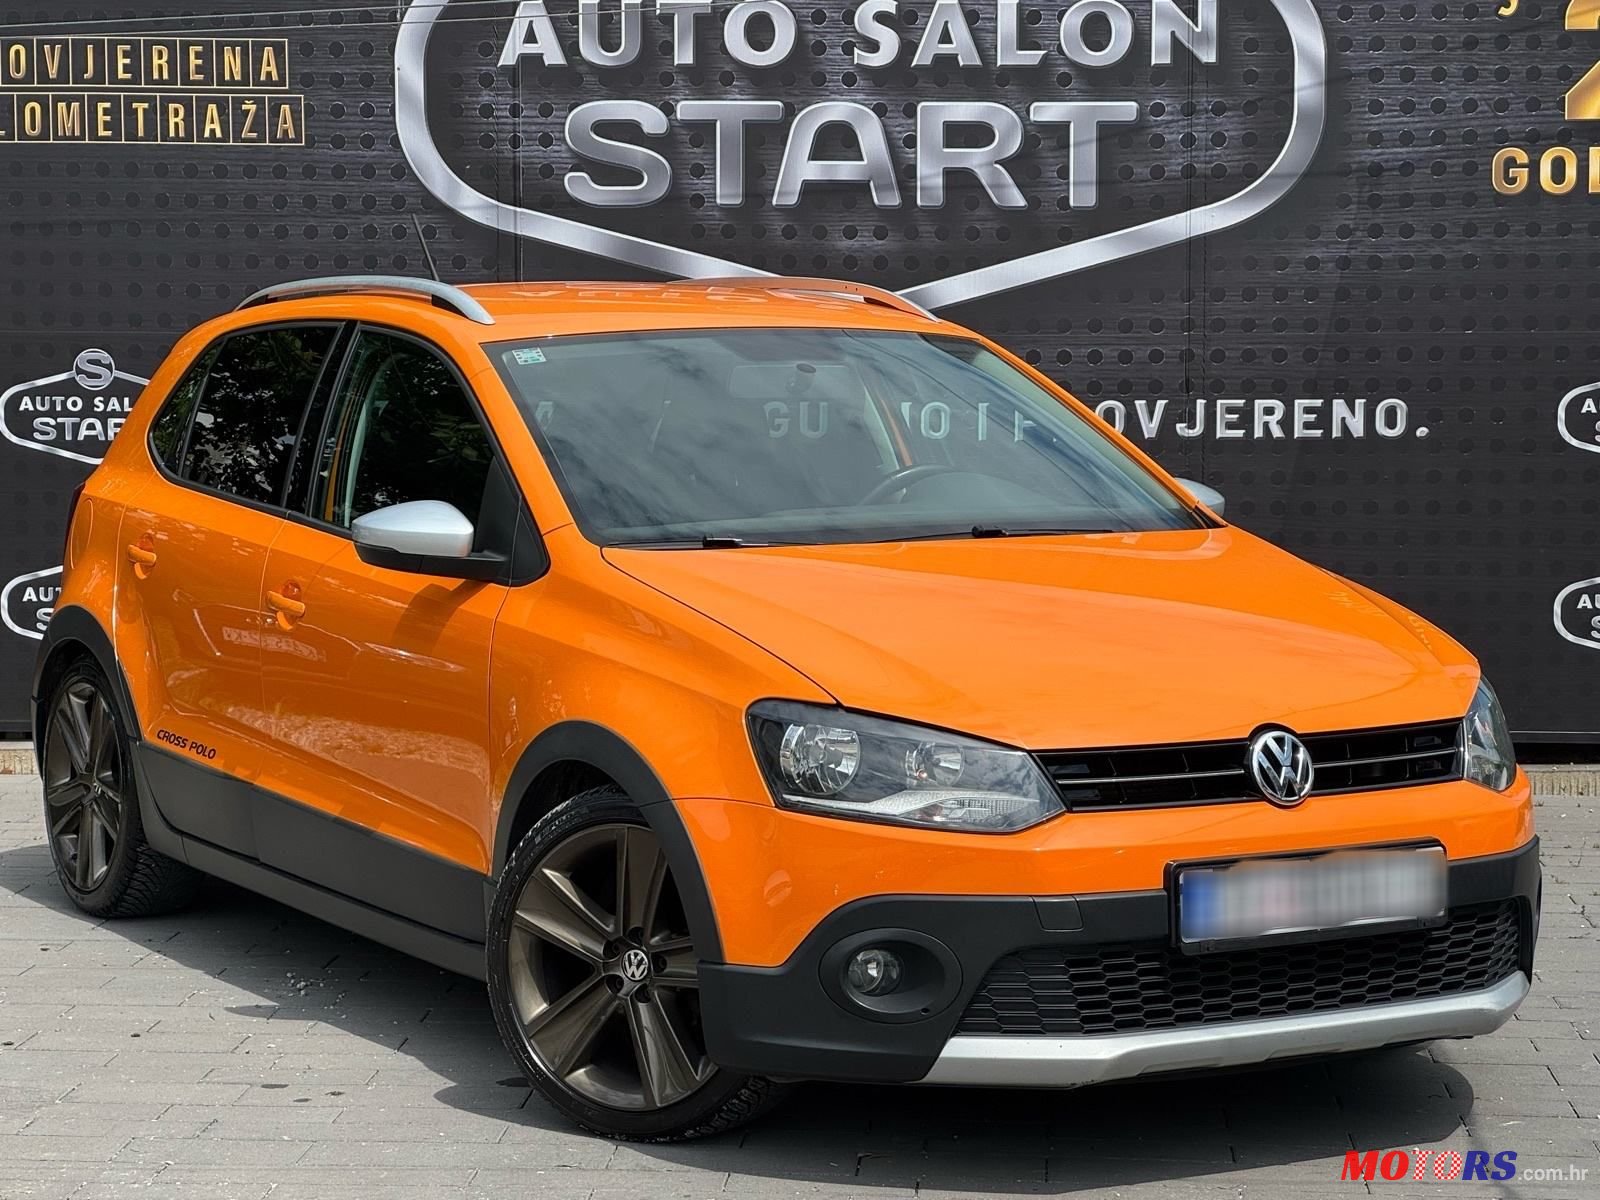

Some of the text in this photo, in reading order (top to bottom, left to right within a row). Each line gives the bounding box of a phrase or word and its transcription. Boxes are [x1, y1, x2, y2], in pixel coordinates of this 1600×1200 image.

[497, 0, 1219, 66] AUTO SALON
[8, 43, 279, 82] OVJERENA
[0, 100, 297, 139] OMETRAŽA
[563, 100, 1139, 208] START
[19, 396, 83, 412] AUTO
[1014, 397, 1429, 443] OVJERENO.
[156, 729, 217, 760] CROSS POLO
